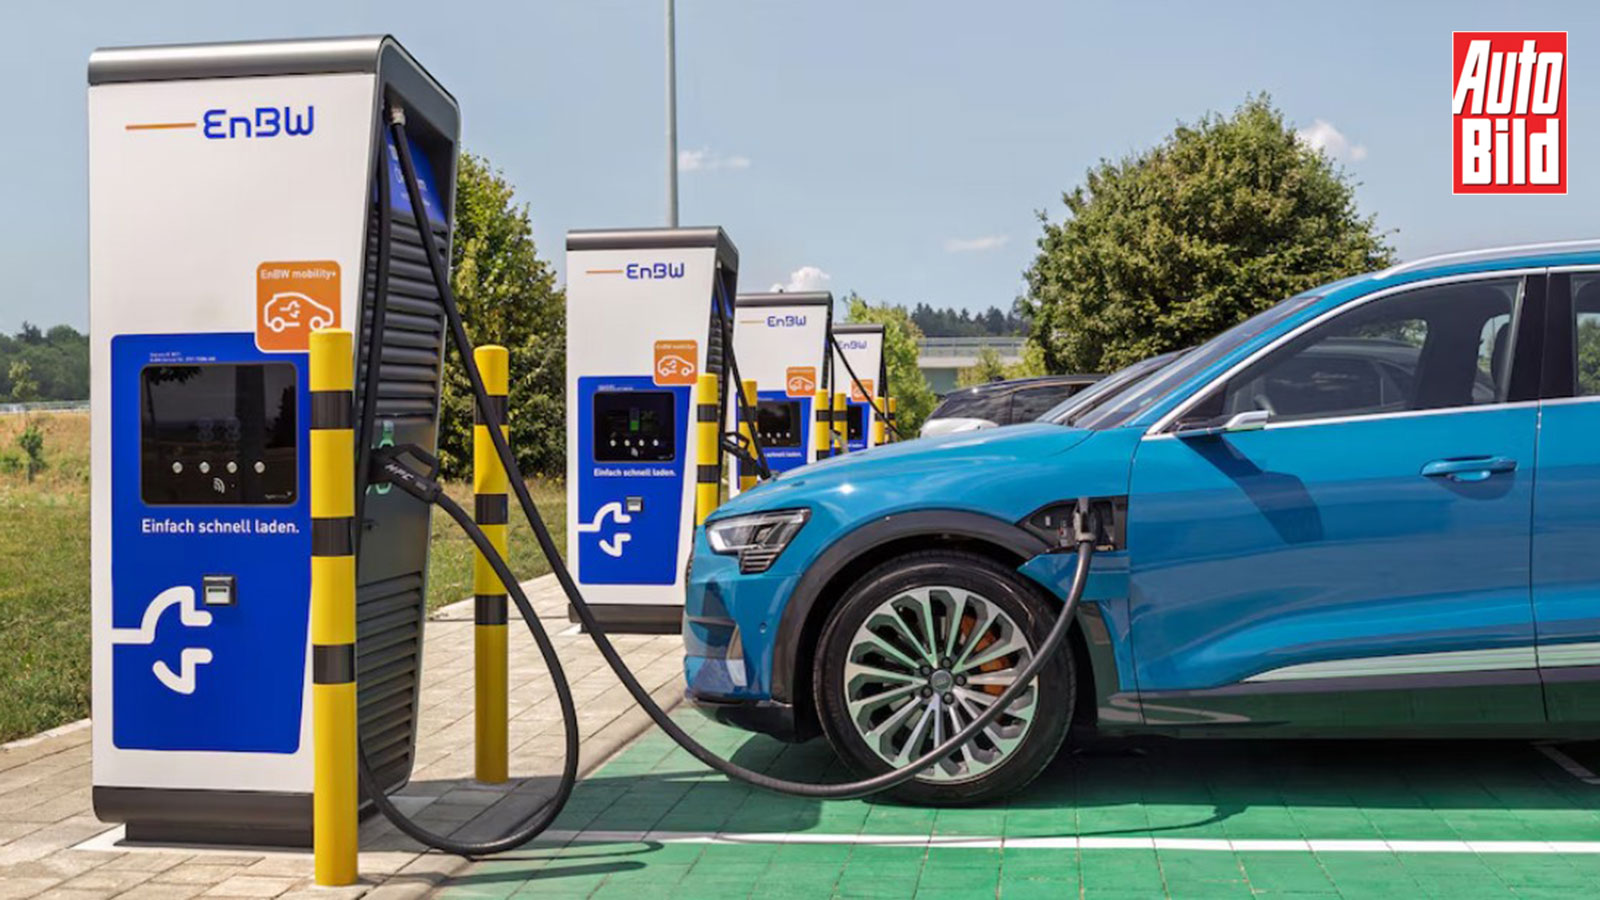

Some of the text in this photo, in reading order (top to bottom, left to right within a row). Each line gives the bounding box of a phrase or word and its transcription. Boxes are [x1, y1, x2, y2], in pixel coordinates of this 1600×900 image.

[203, 105, 314, 139] EnBW
[260, 269, 290, 280] EnBW
[626, 262, 685, 279] EnBW
[767, 315, 807, 328] EnBW
[141, 519, 300, 534] Einfach schnell laden.
